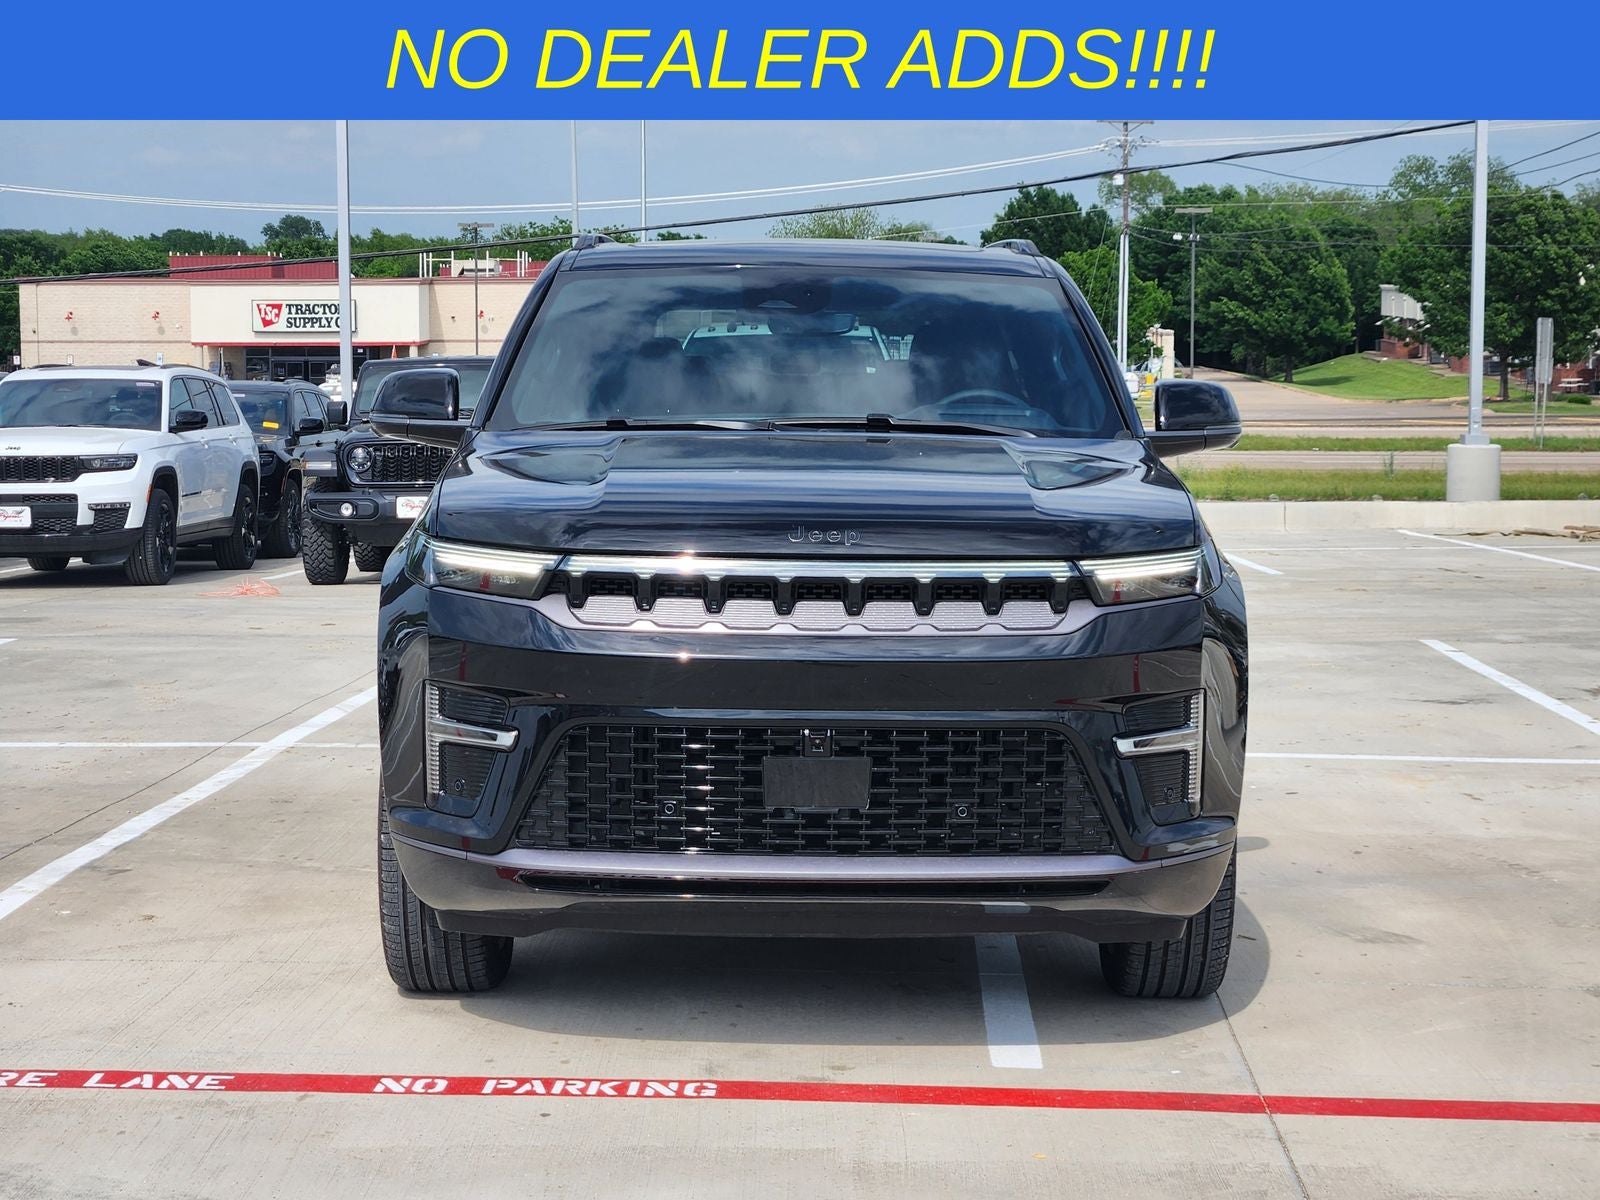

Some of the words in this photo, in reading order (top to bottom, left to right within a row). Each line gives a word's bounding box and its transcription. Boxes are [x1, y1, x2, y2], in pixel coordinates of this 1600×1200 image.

[260, 304, 279, 323] TSC
[285, 303, 340, 315] TRACTO
[286, 316, 334, 328] SUPPLY
[787, 525, 861, 546] Jeep
[82, 1073, 235, 1090] LANE
[372, 1077, 449, 1093] NO
[481, 1078, 718, 1098] PARKING
